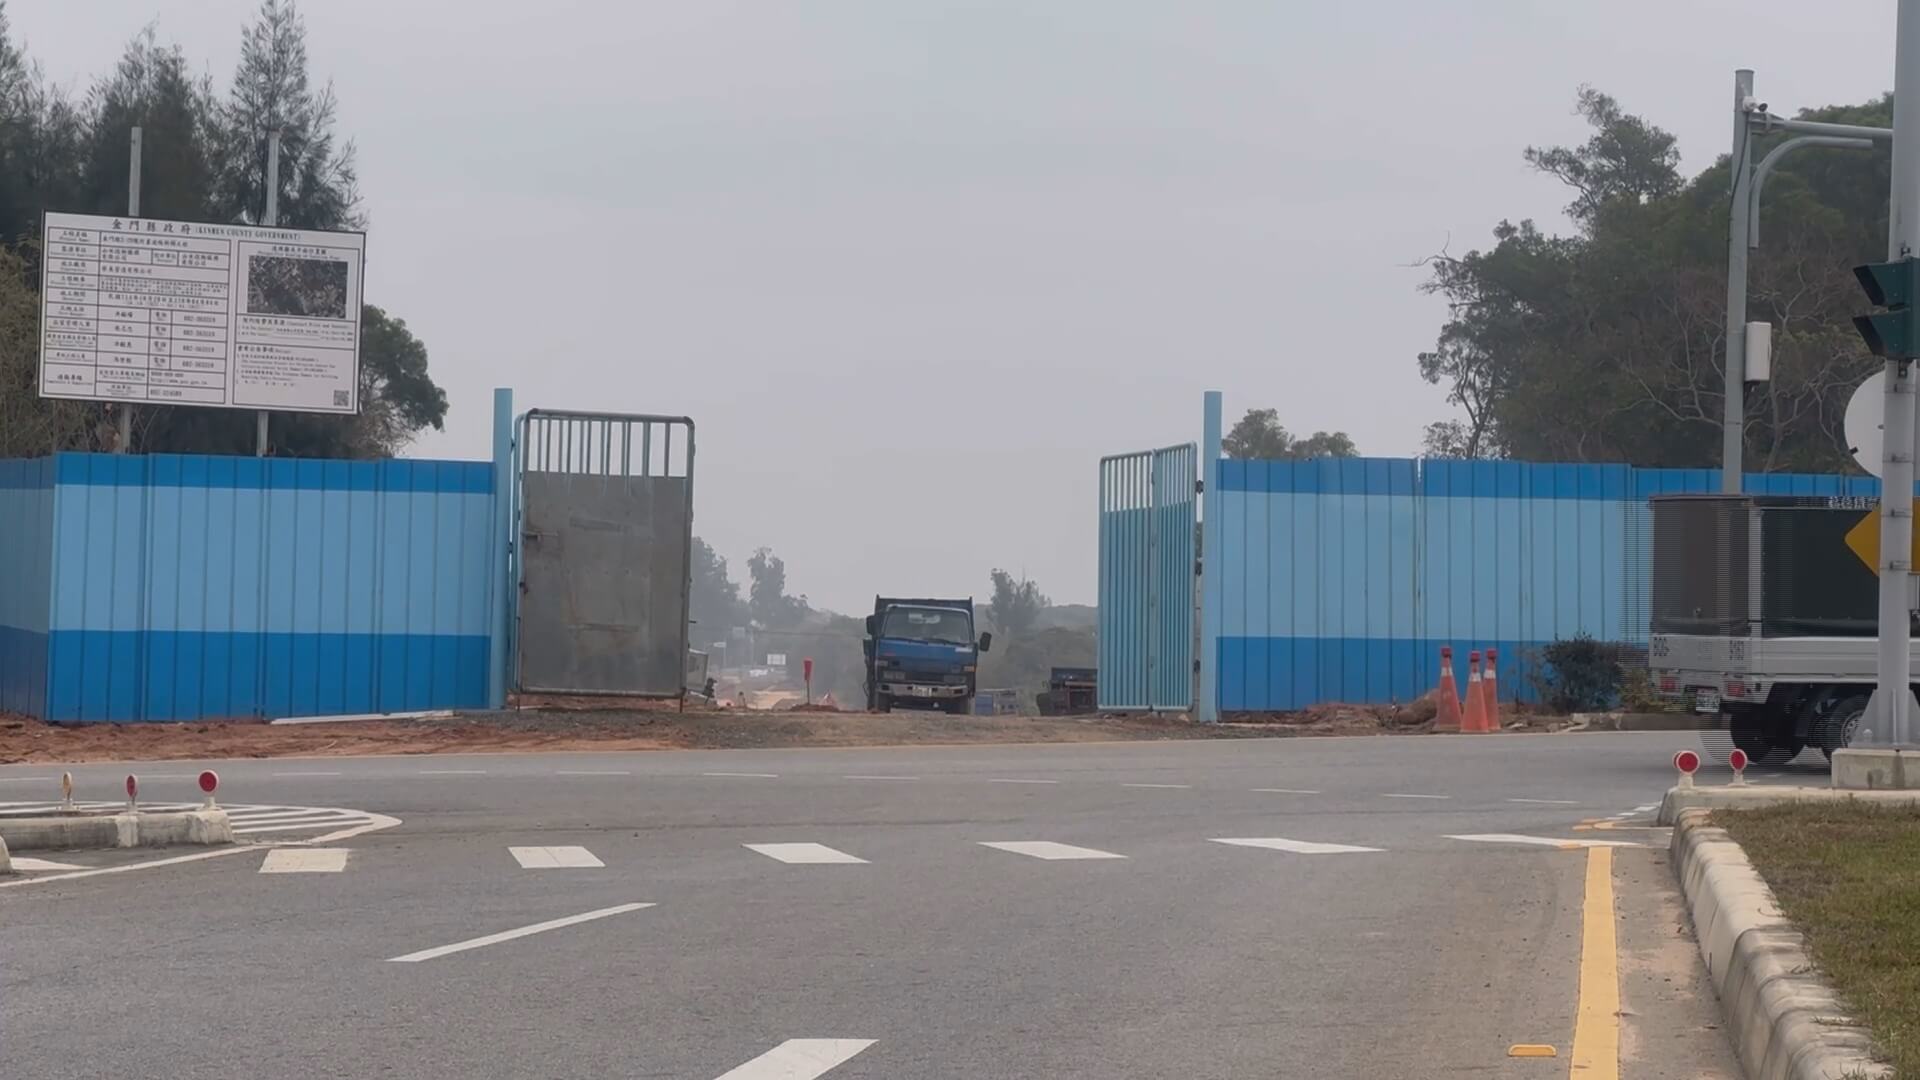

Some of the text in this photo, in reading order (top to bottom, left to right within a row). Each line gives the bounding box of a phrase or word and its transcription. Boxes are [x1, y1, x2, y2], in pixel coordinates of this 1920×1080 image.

[112, 218, 191, 235] 金門縣政府
[226, 228, 253, 238] COUNTY
